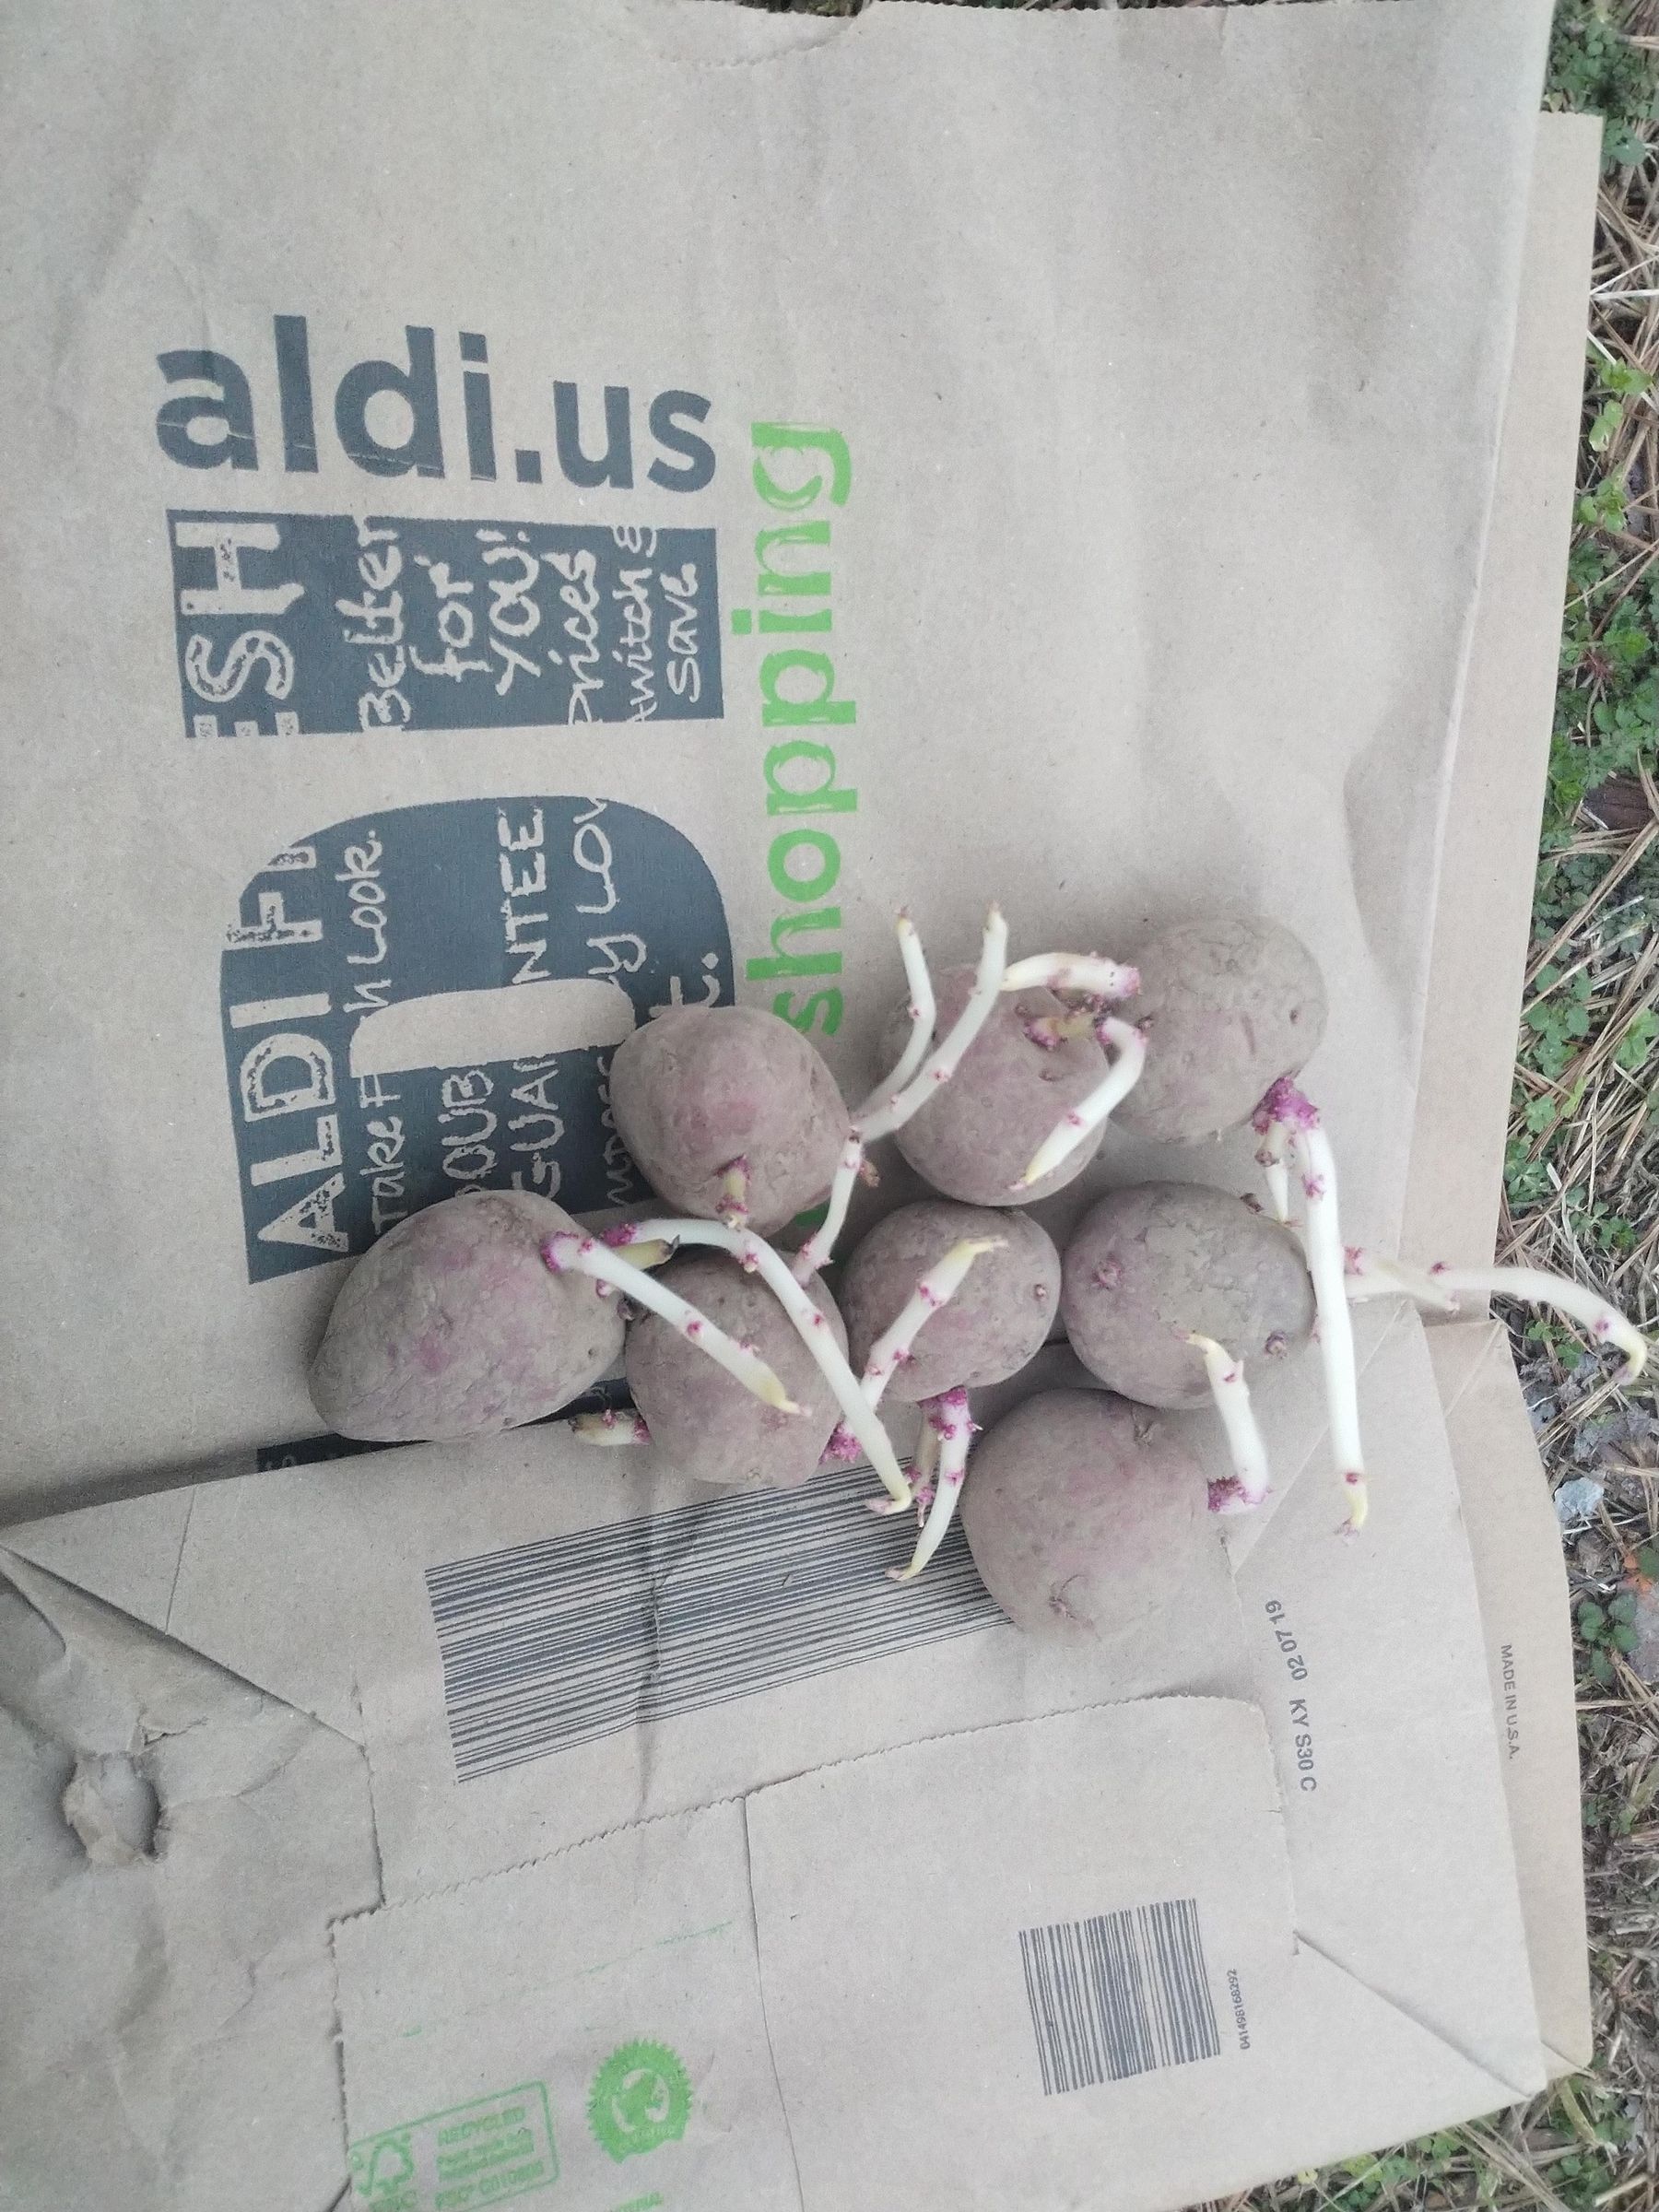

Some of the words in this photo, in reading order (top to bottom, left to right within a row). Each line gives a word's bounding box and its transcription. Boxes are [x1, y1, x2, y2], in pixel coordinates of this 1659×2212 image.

[156, 314, 717, 492] aldi.us
[407, 553, 494, 683] for
[731, 421, 858, 1036] shopping
[229, 994, 349, 1253] ALDI
[1500, 1644, 1516, 1691] MADE
[1288, 1698, 1311, 1728] KY
[1504, 1694, 1518, 1711] IN
[1294, 1733, 1315, 1771] S30
[1506, 1713, 1521, 1759] U.S.A.
[1299, 1775, 1318, 1793] C
